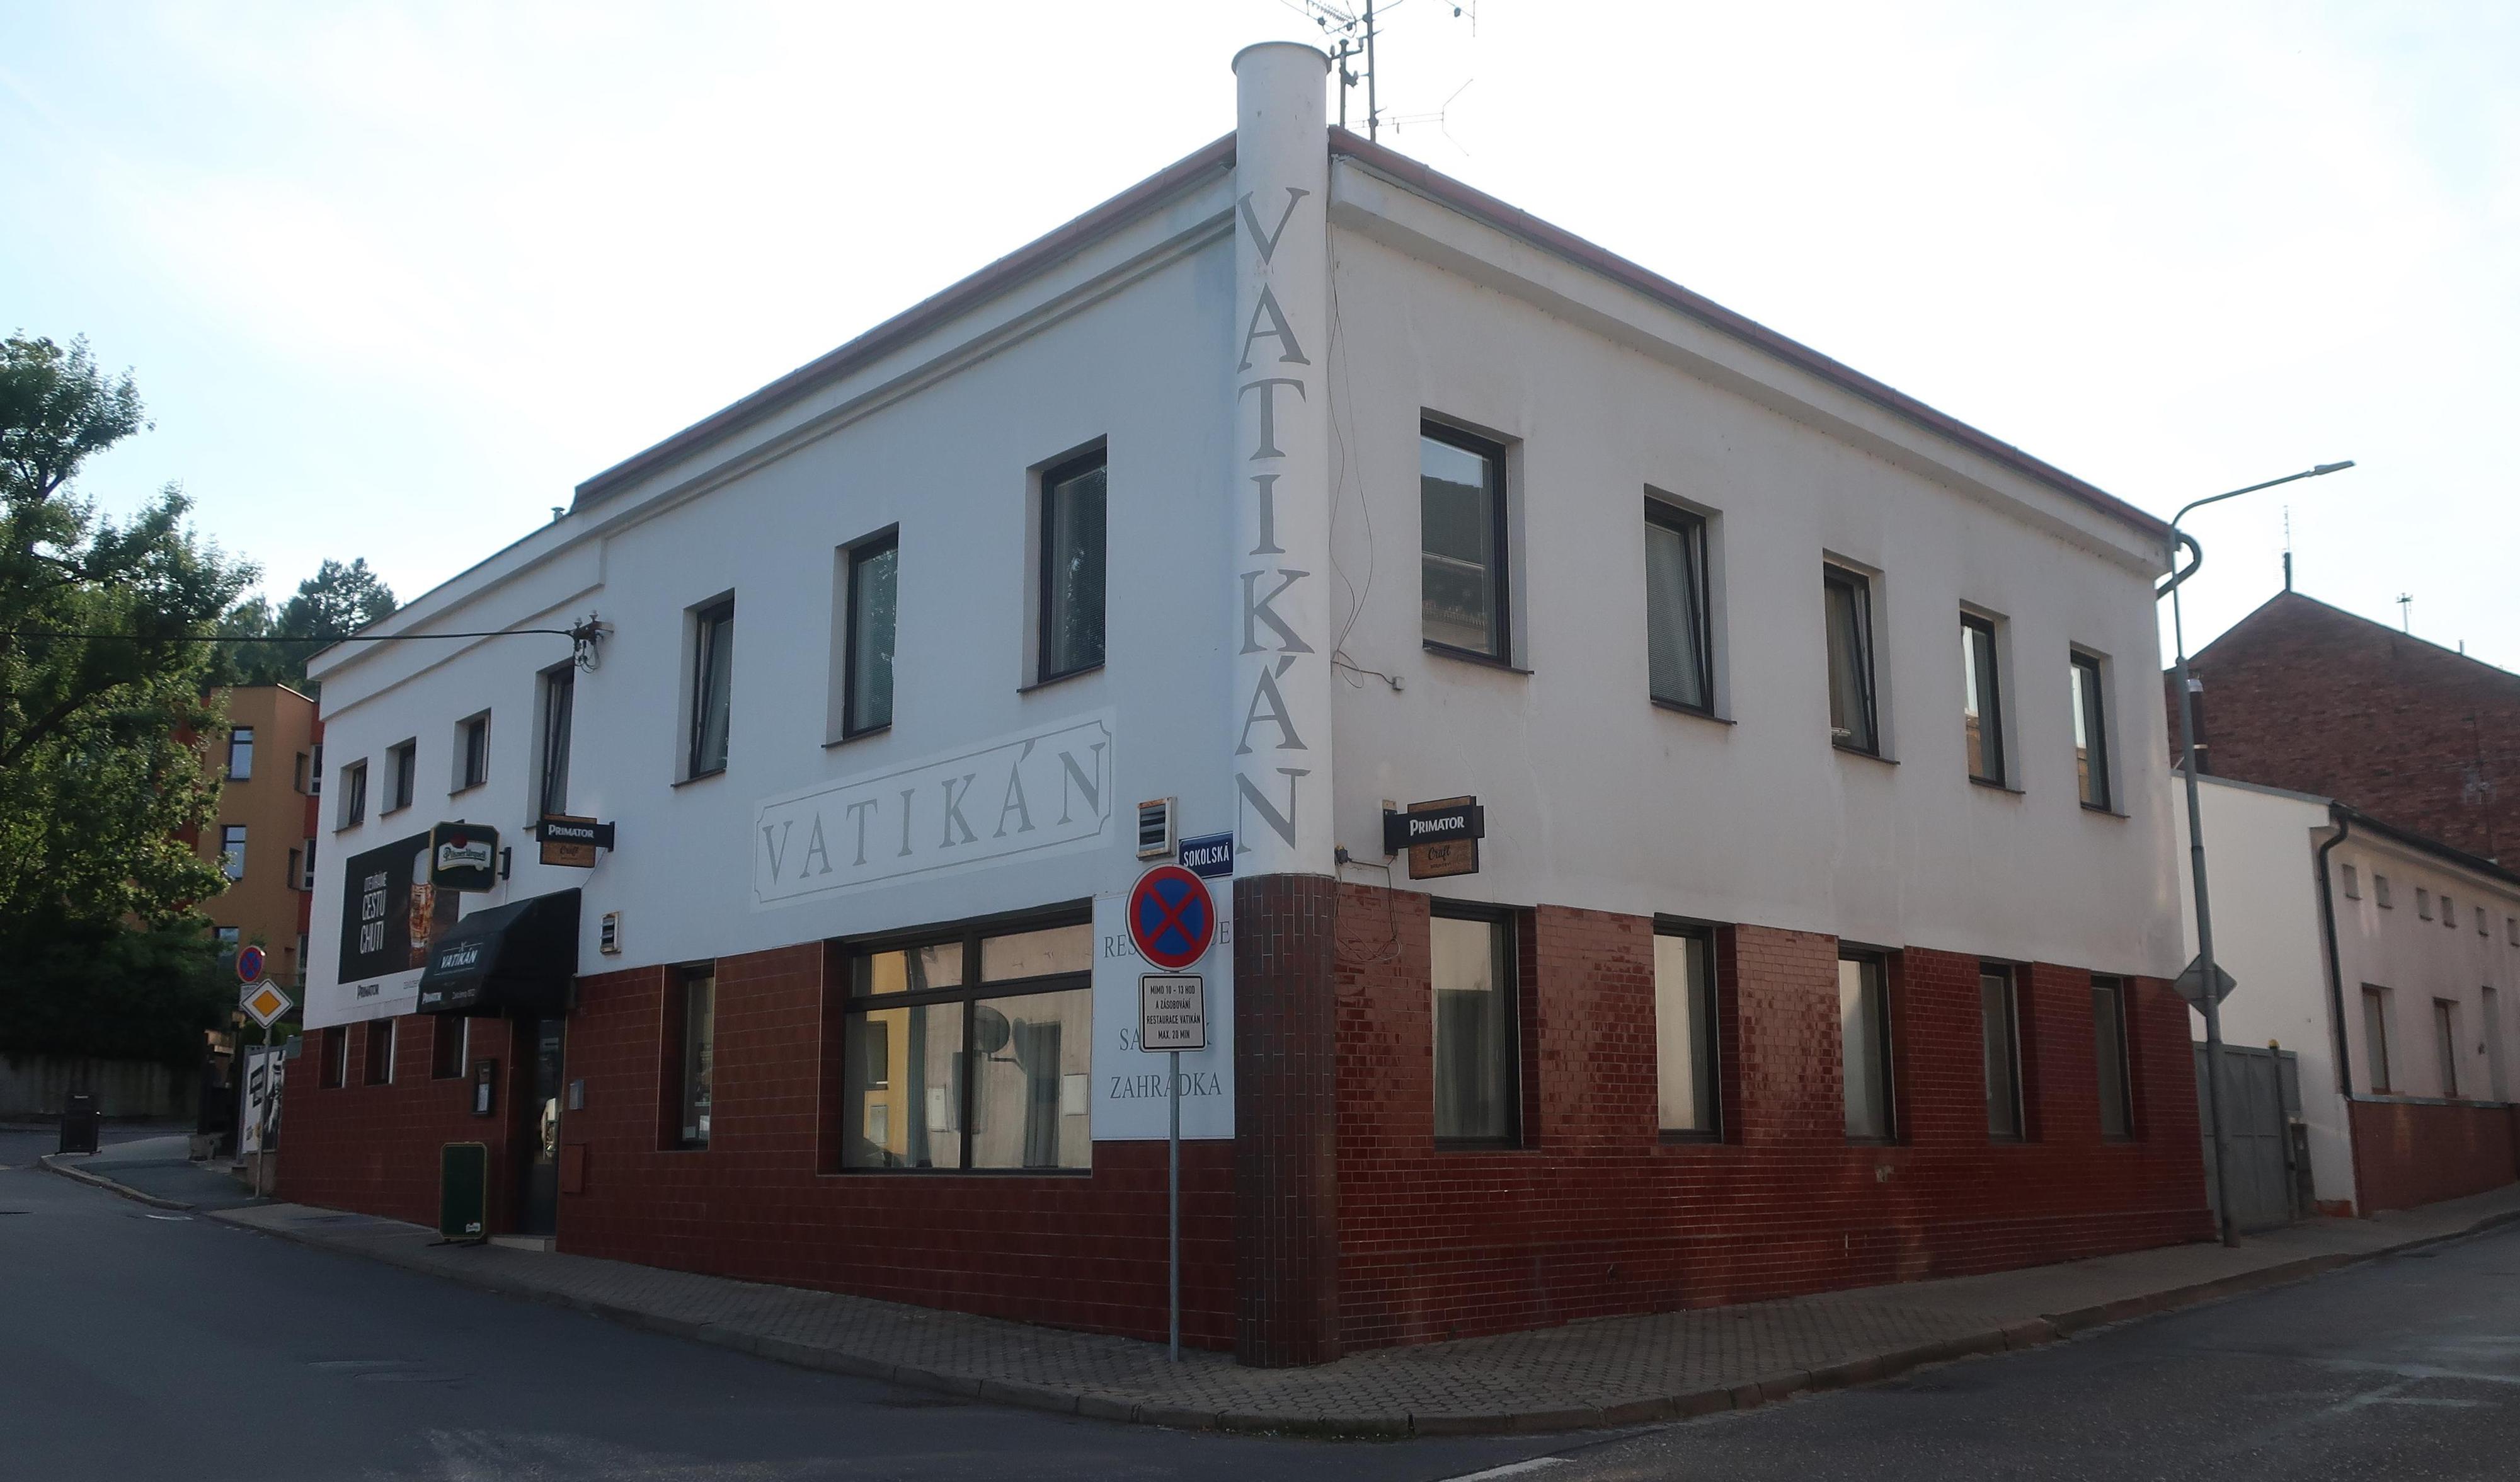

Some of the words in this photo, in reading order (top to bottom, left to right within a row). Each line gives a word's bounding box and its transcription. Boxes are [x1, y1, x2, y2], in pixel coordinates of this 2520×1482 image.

[1235, 187, 1315, 854] VATIKÁN
[762, 738, 1106, 885] VATIKÁN
[547, 824, 594, 838] PRIMATOR
[1409, 816, 1465, 837] PRIMATOR
[1183, 842, 1229, 867] SOKOLSKÁ
[1428, 844, 1451, 861] Craft
[441, 948, 478, 968] VATIKÁN
[1150, 985, 1164, 995] MIMO
[1177, 985, 1184, 994] 13
[1185, 985, 1195, 994] HOD
[1155, 1001, 1159, 1009] A
[1160, 998, 1191, 1009] ZÁSOBOVÁNÍ
[1146, 1014, 1178, 1025] RESTAURACE
[1179, 1013, 1201, 1024] VATIKÁN
[1158, 1030, 1170, 1039] MAX.
[1172, 1030, 1178, 1039] 20
[1179, 1030, 1190, 1039] MIN
